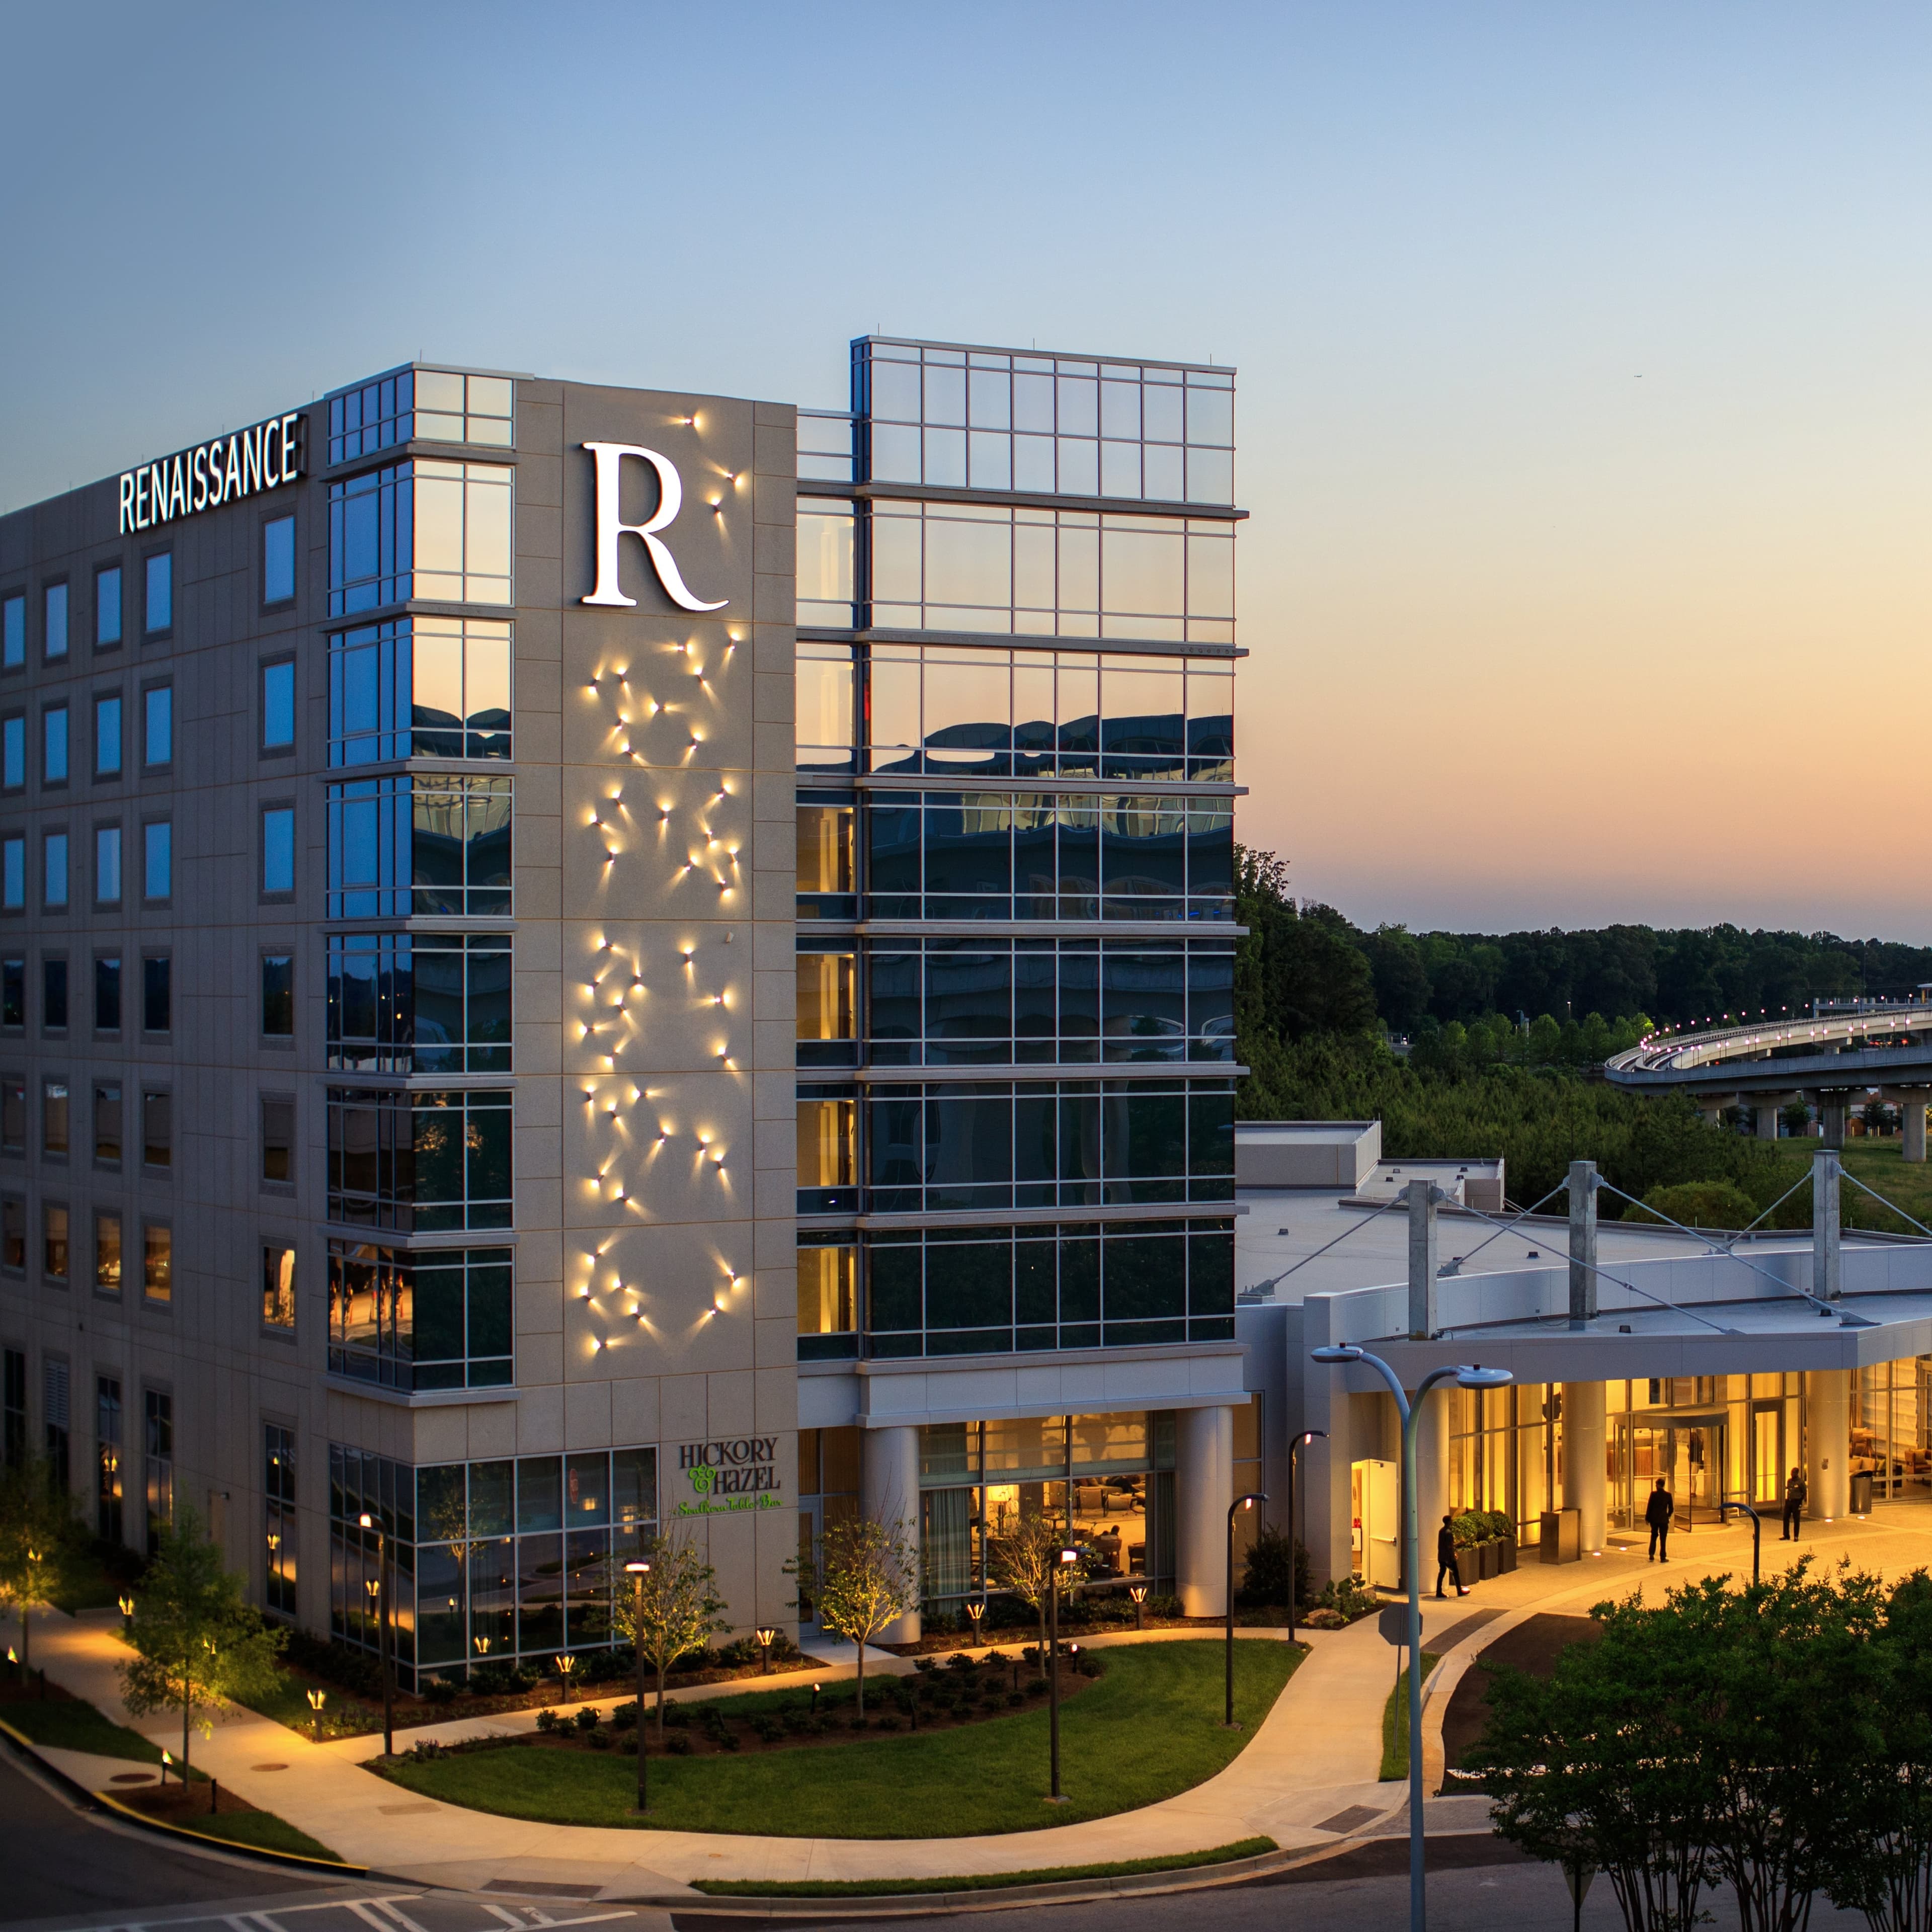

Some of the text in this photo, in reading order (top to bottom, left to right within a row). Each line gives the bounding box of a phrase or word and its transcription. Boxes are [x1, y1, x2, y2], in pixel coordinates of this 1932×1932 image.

[120, 413, 299, 535] RENAISSANCE
[581, 441, 730, 612] R
[679, 1437, 778, 1469] HICKORY
[688, 1465, 716, 1493] &
[679, 1499, 727, 1515] Southern
[726, 1496, 754, 1510] Table
